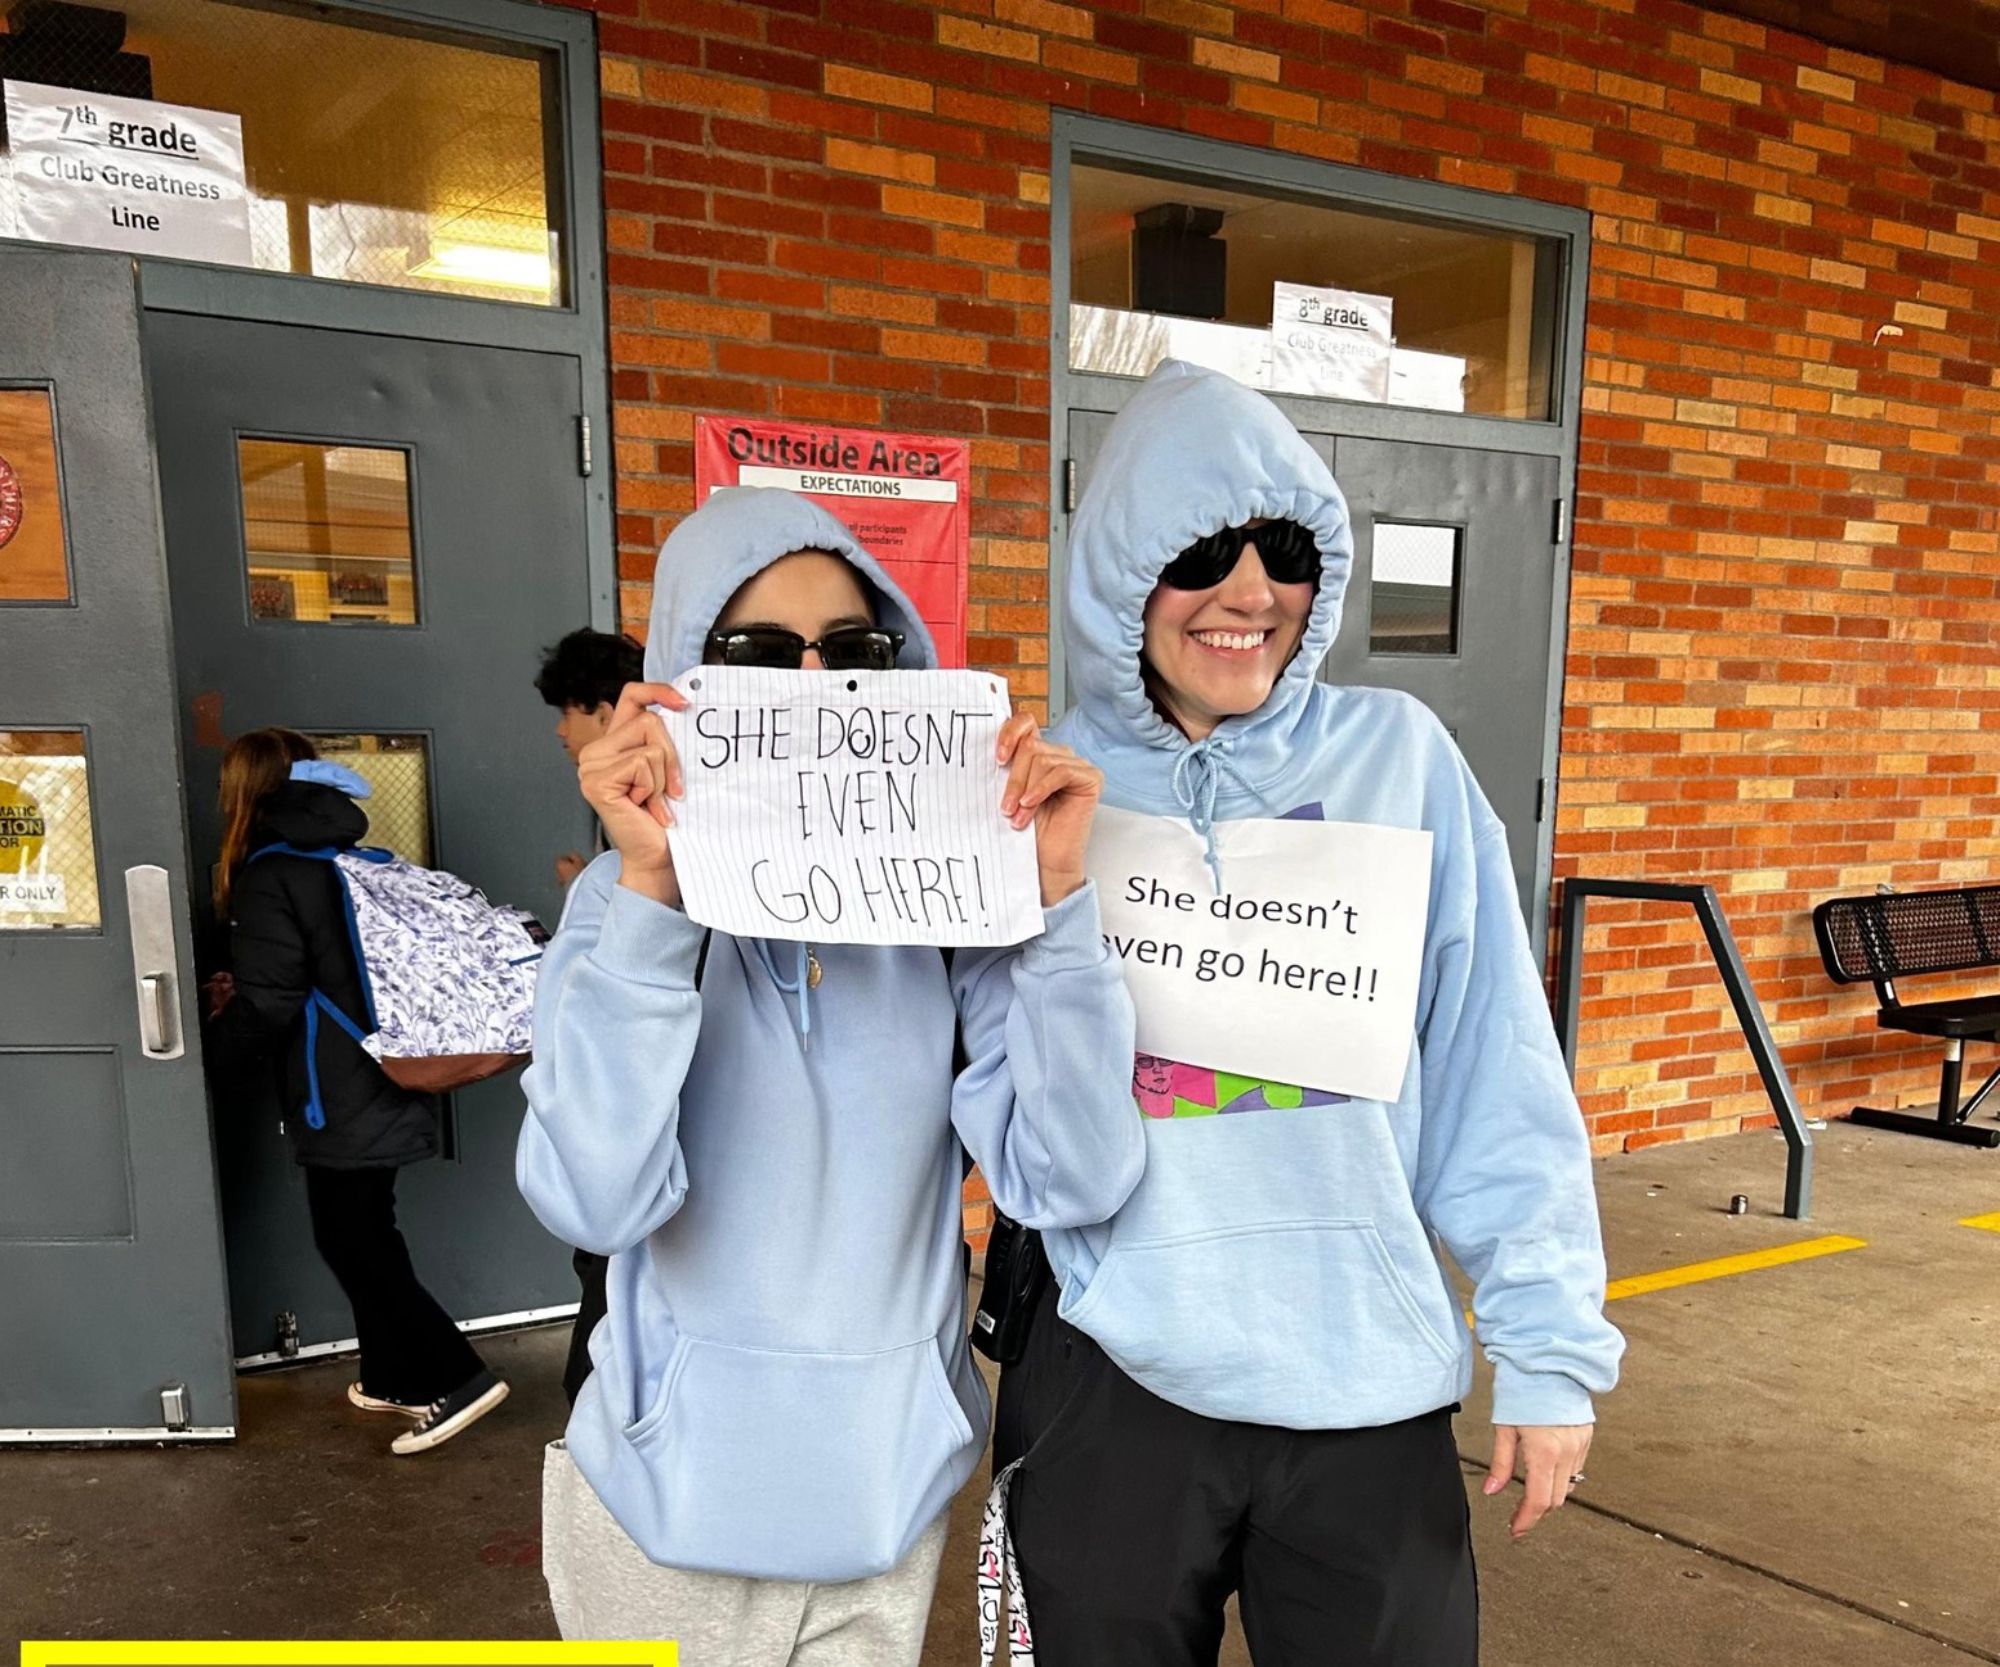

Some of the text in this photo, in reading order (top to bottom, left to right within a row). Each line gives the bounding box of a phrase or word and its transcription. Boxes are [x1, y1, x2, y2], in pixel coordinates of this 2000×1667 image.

[56, 105, 197, 153] 7th grade
[40, 156, 220, 200] Club Greatness
[112, 206, 160, 231] Line
[1299, 296, 1369, 327] 8th grade
[1288, 331, 1377, 358] Club Greatness
[727, 427, 941, 476] Outside Area
[800, 475, 902, 496] EXPECTATIONS
[857, 535, 903, 546] boundaries
[859, 523, 907, 535] participants
[696, 707, 993, 768] SHE DOESNT
[798, 771, 917, 840] EVEN
[15, 886, 56, 900] ONLY
[752, 855, 990, 927] GO HERE!
[1125, 876, 1359, 935] She doesn’t
[1101, 934, 1378, 1002] ven go here!!
